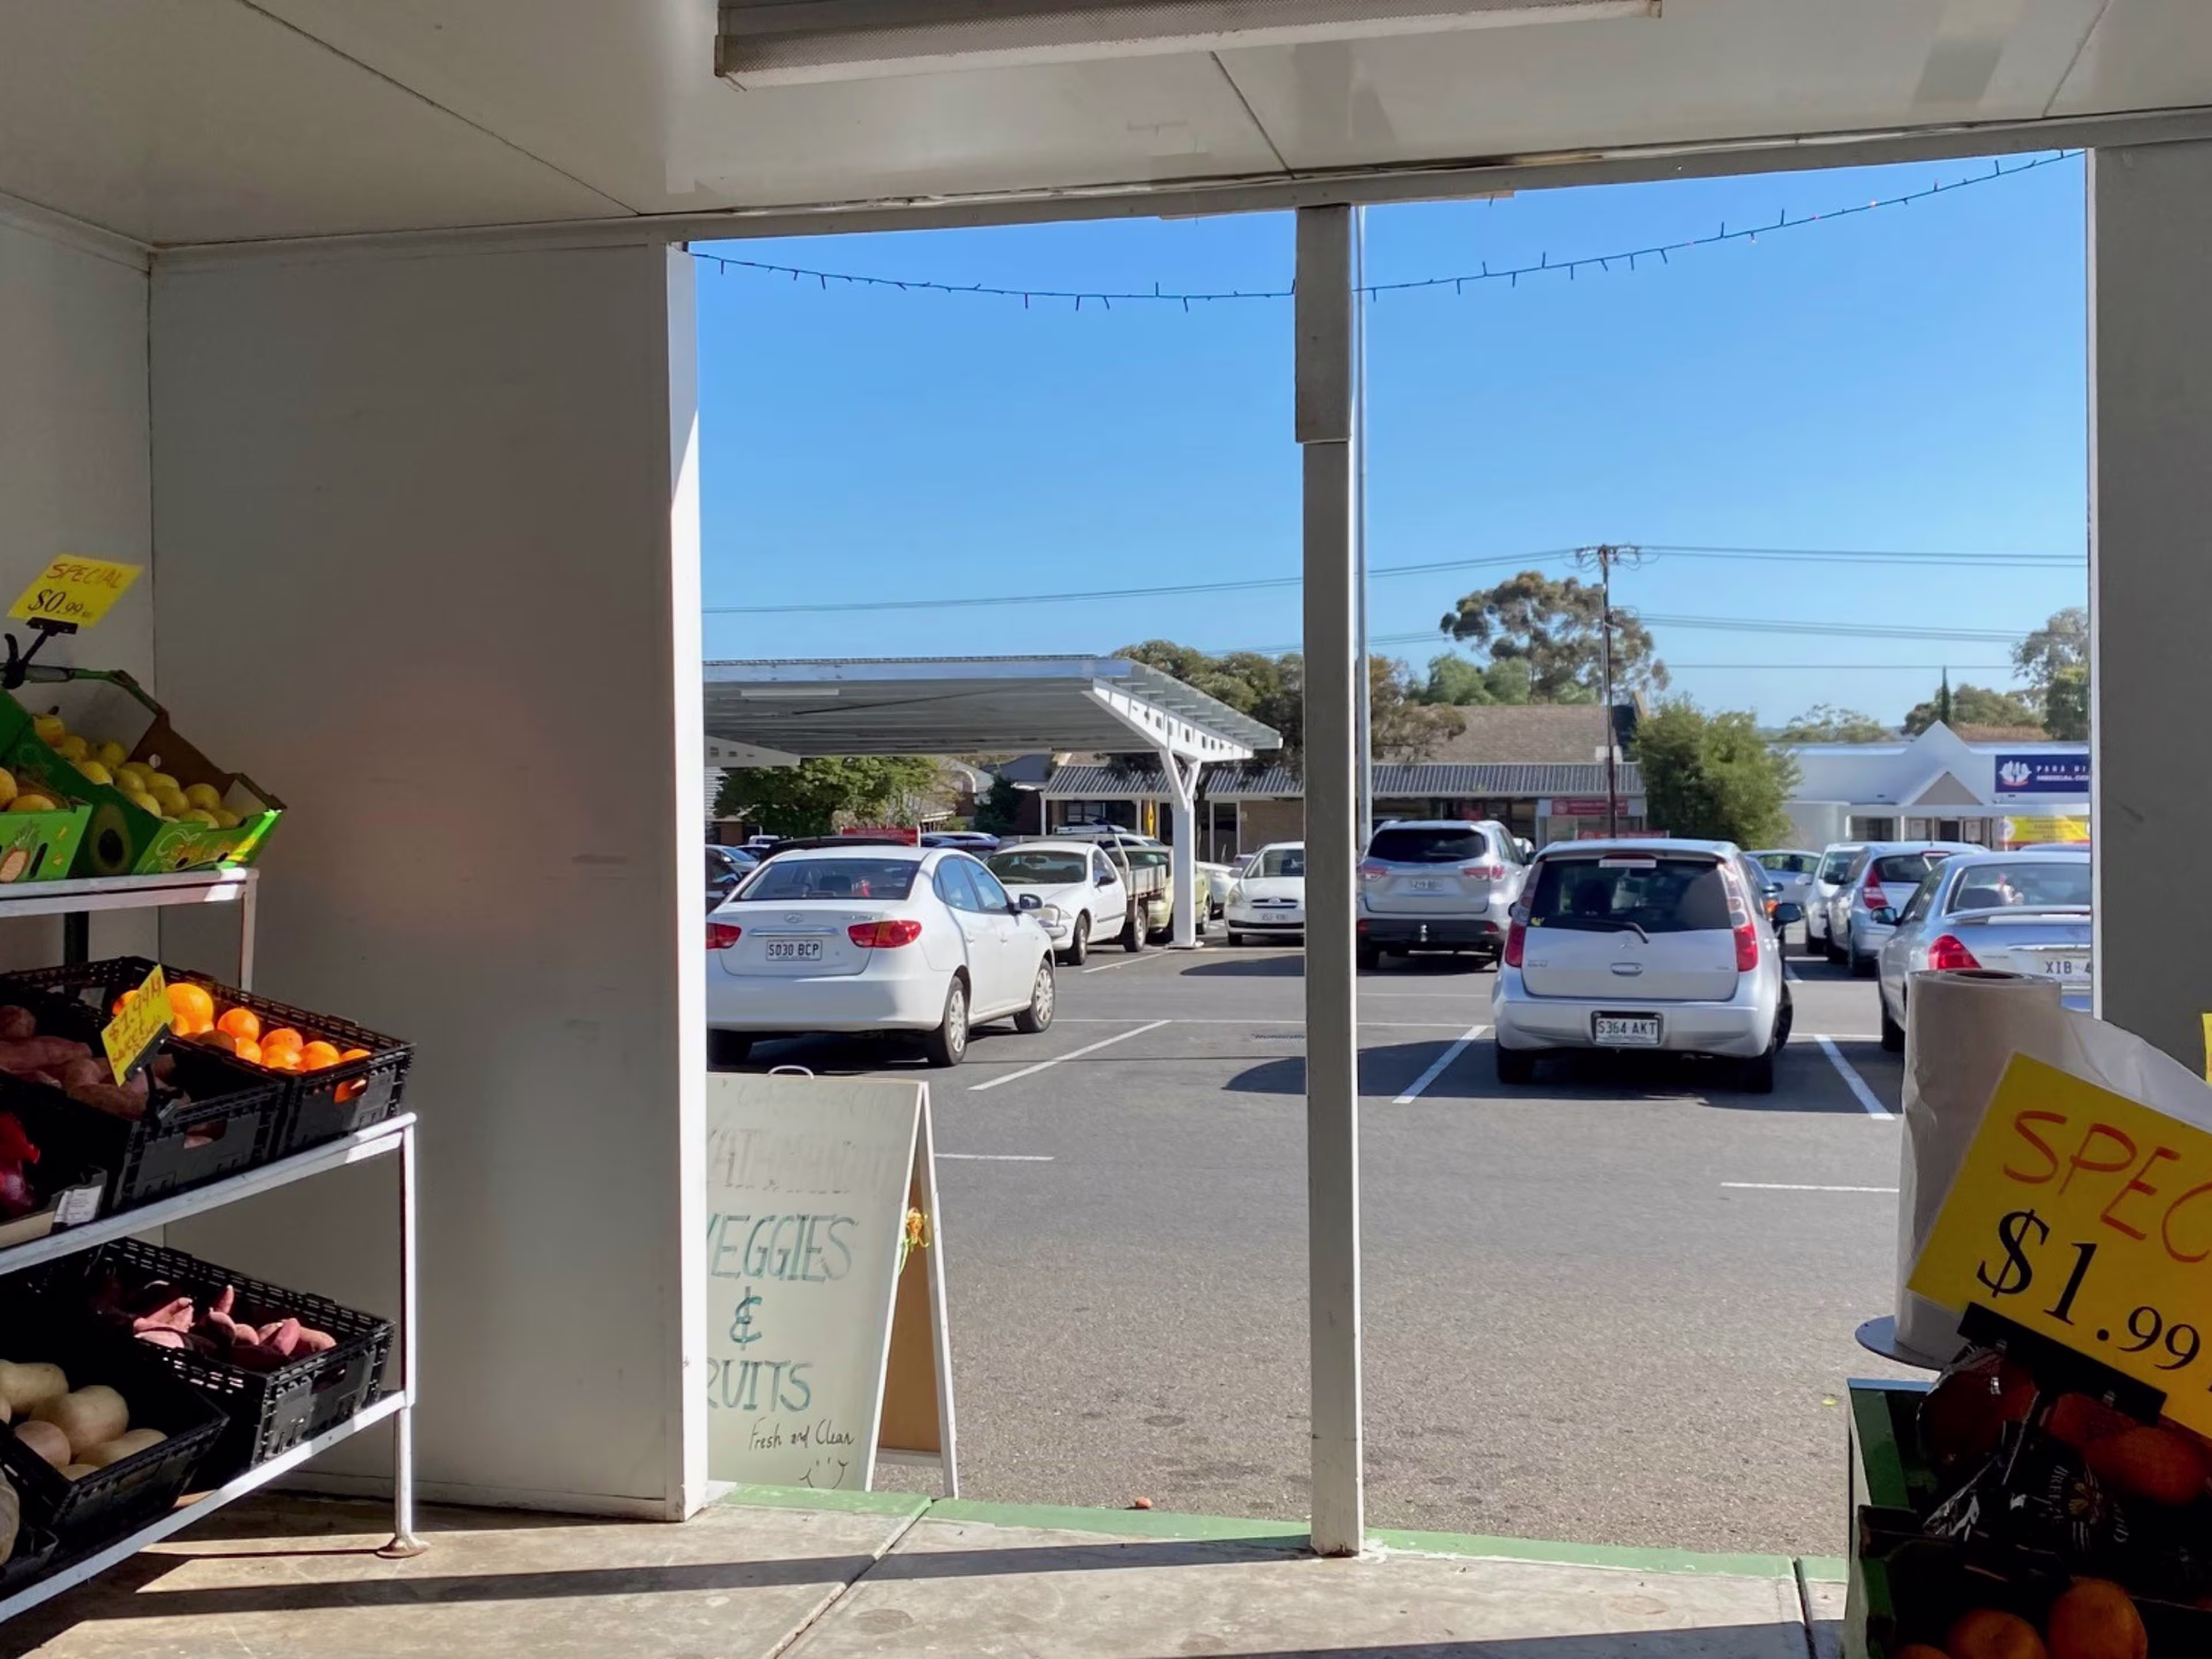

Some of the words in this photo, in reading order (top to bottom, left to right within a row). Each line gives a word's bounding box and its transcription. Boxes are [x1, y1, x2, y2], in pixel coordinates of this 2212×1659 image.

[798, 943, 819, 956] BCP
[2045, 961, 2071, 974] XIB
[1597, 1021, 1626, 1034] S364
[1632, 1021, 1656, 1035] AKT
[749, 1416, 782, 1452] Fresh
[790, 1425, 810, 1448] and
[816, 1418, 855, 1445] Clean
